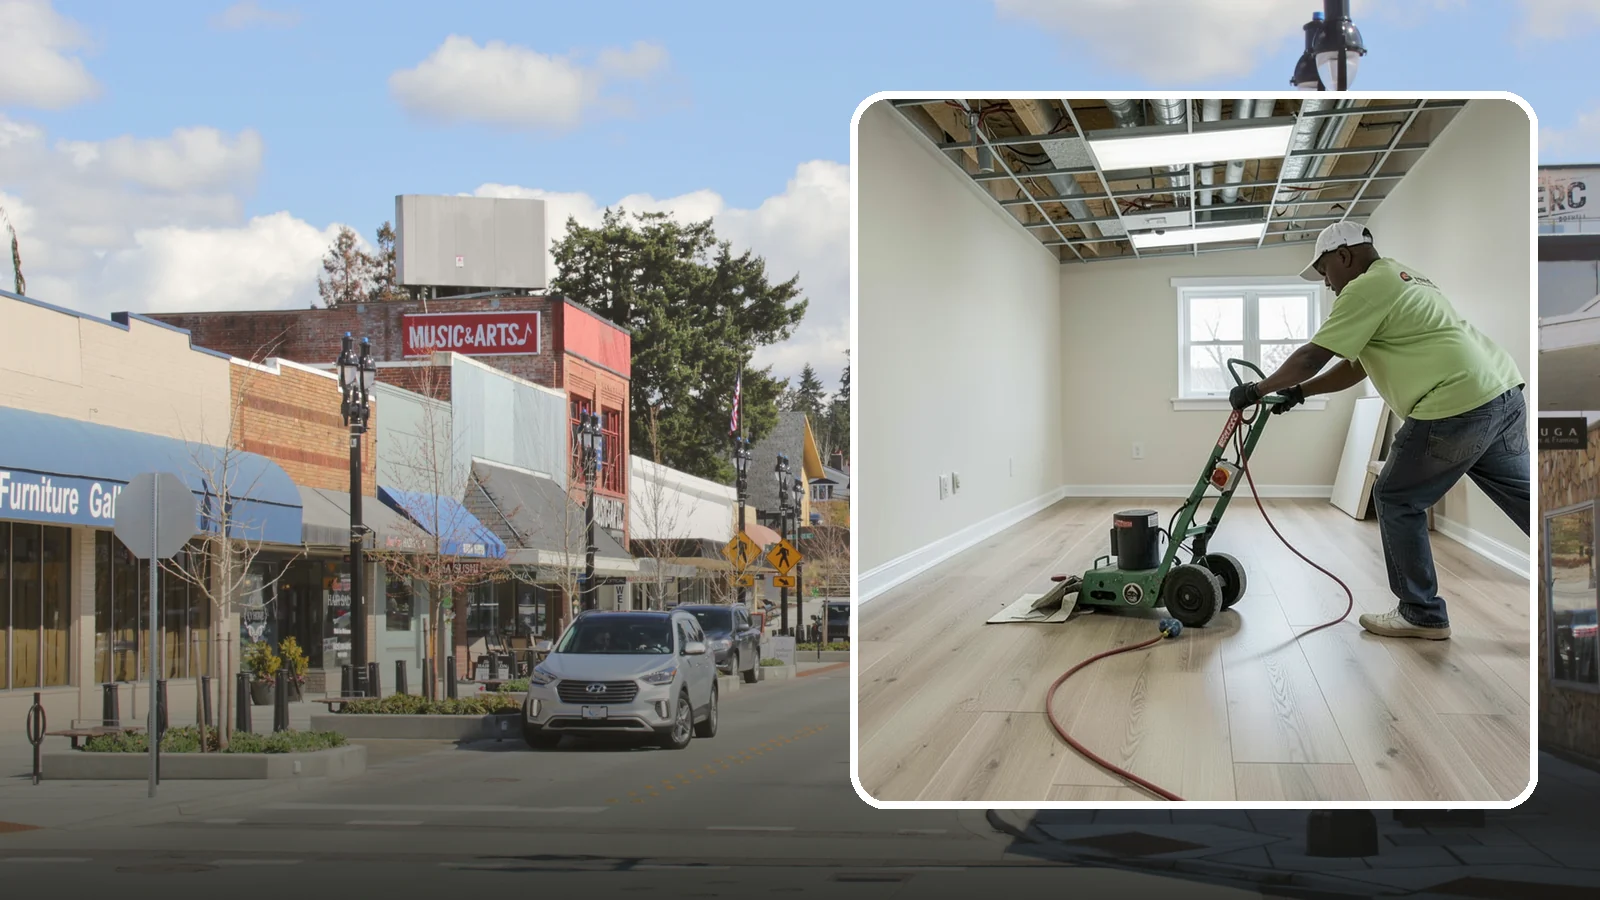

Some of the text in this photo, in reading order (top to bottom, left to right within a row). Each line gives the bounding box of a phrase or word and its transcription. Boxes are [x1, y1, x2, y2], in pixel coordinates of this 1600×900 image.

[409, 323, 520, 349] MUSIC&ARTS
[0, 471, 79, 515] Furniture
[453, 563, 479, 574] SUSHI
